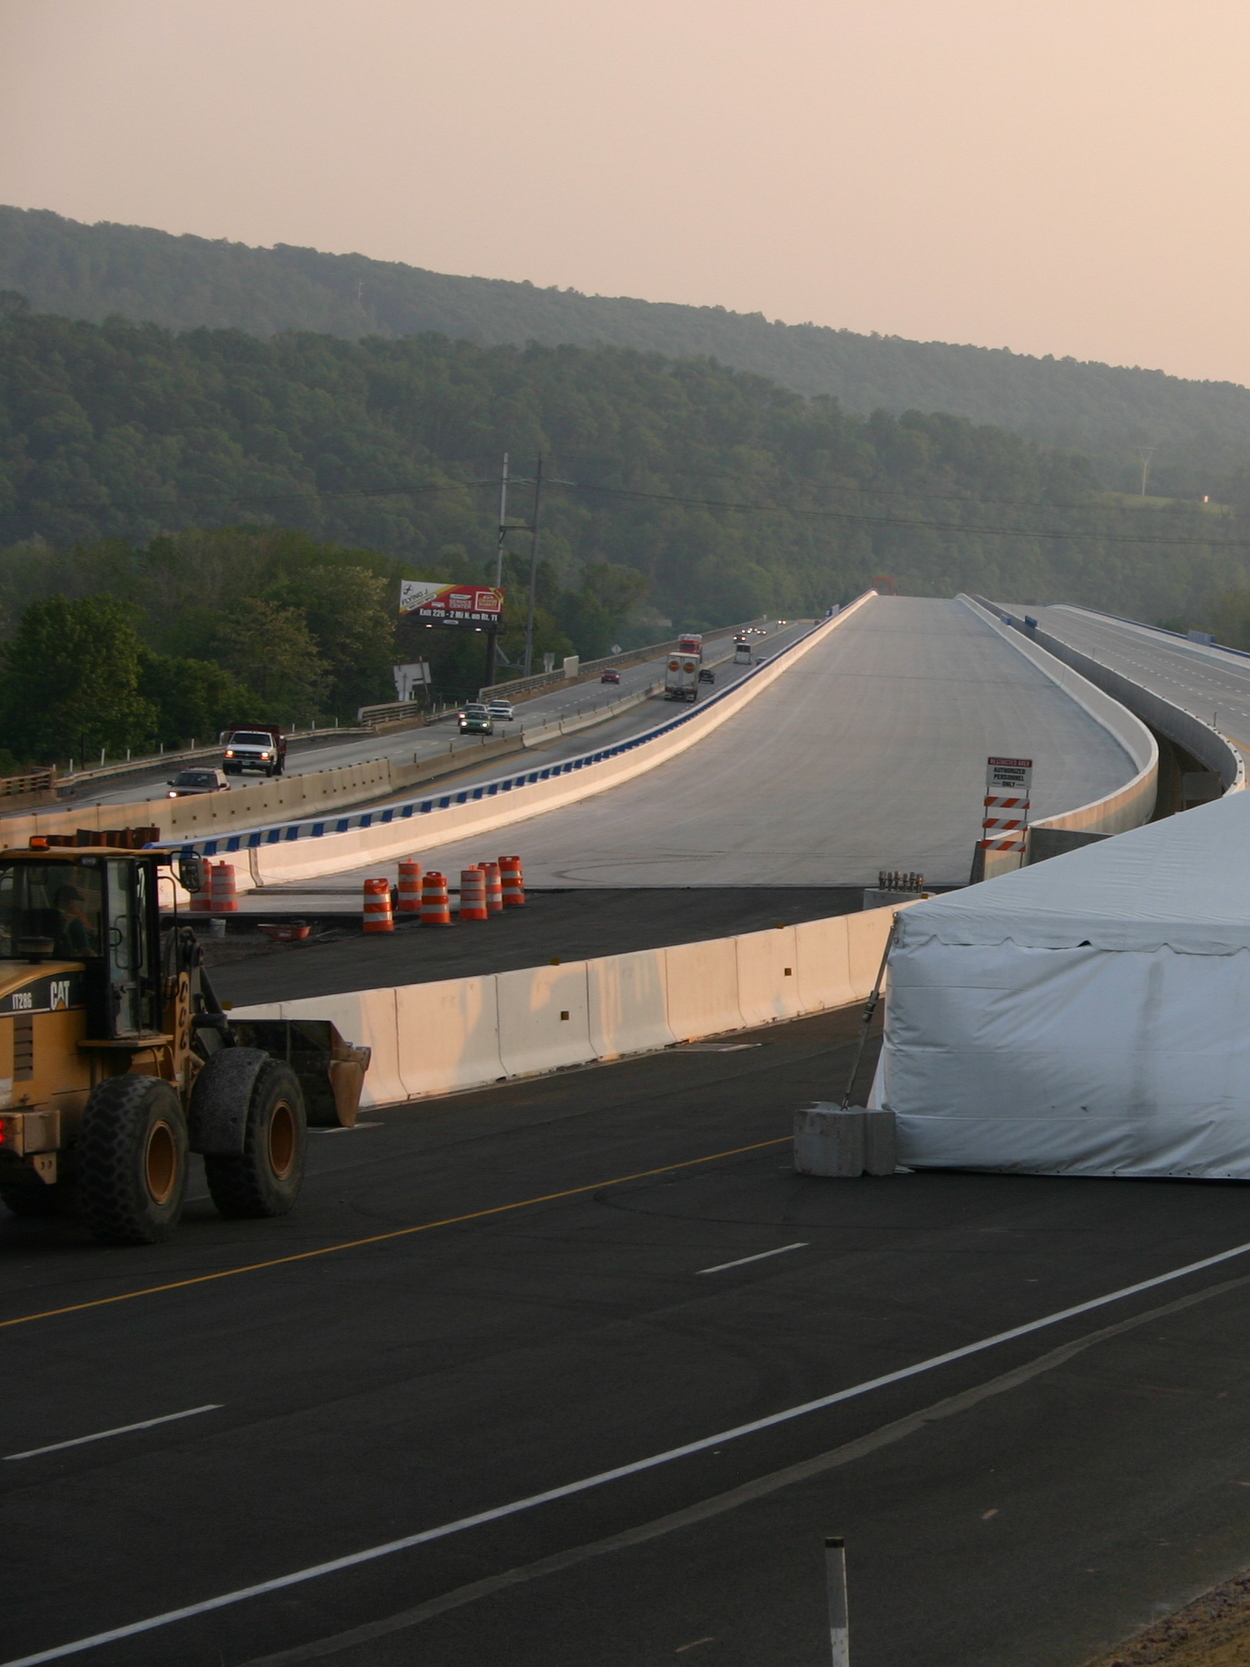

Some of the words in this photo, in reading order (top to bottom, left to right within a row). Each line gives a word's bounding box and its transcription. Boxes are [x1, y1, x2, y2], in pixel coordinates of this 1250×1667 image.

[401, 592, 424, 606] FLYING
[420, 608, 431, 616] Exit
[491, 614, 498, 622] 11
[990, 758, 1017, 766] RESTRICTED
[12, 992, 32, 1010] IT28G
[50, 980, 70, 1010] CAT
